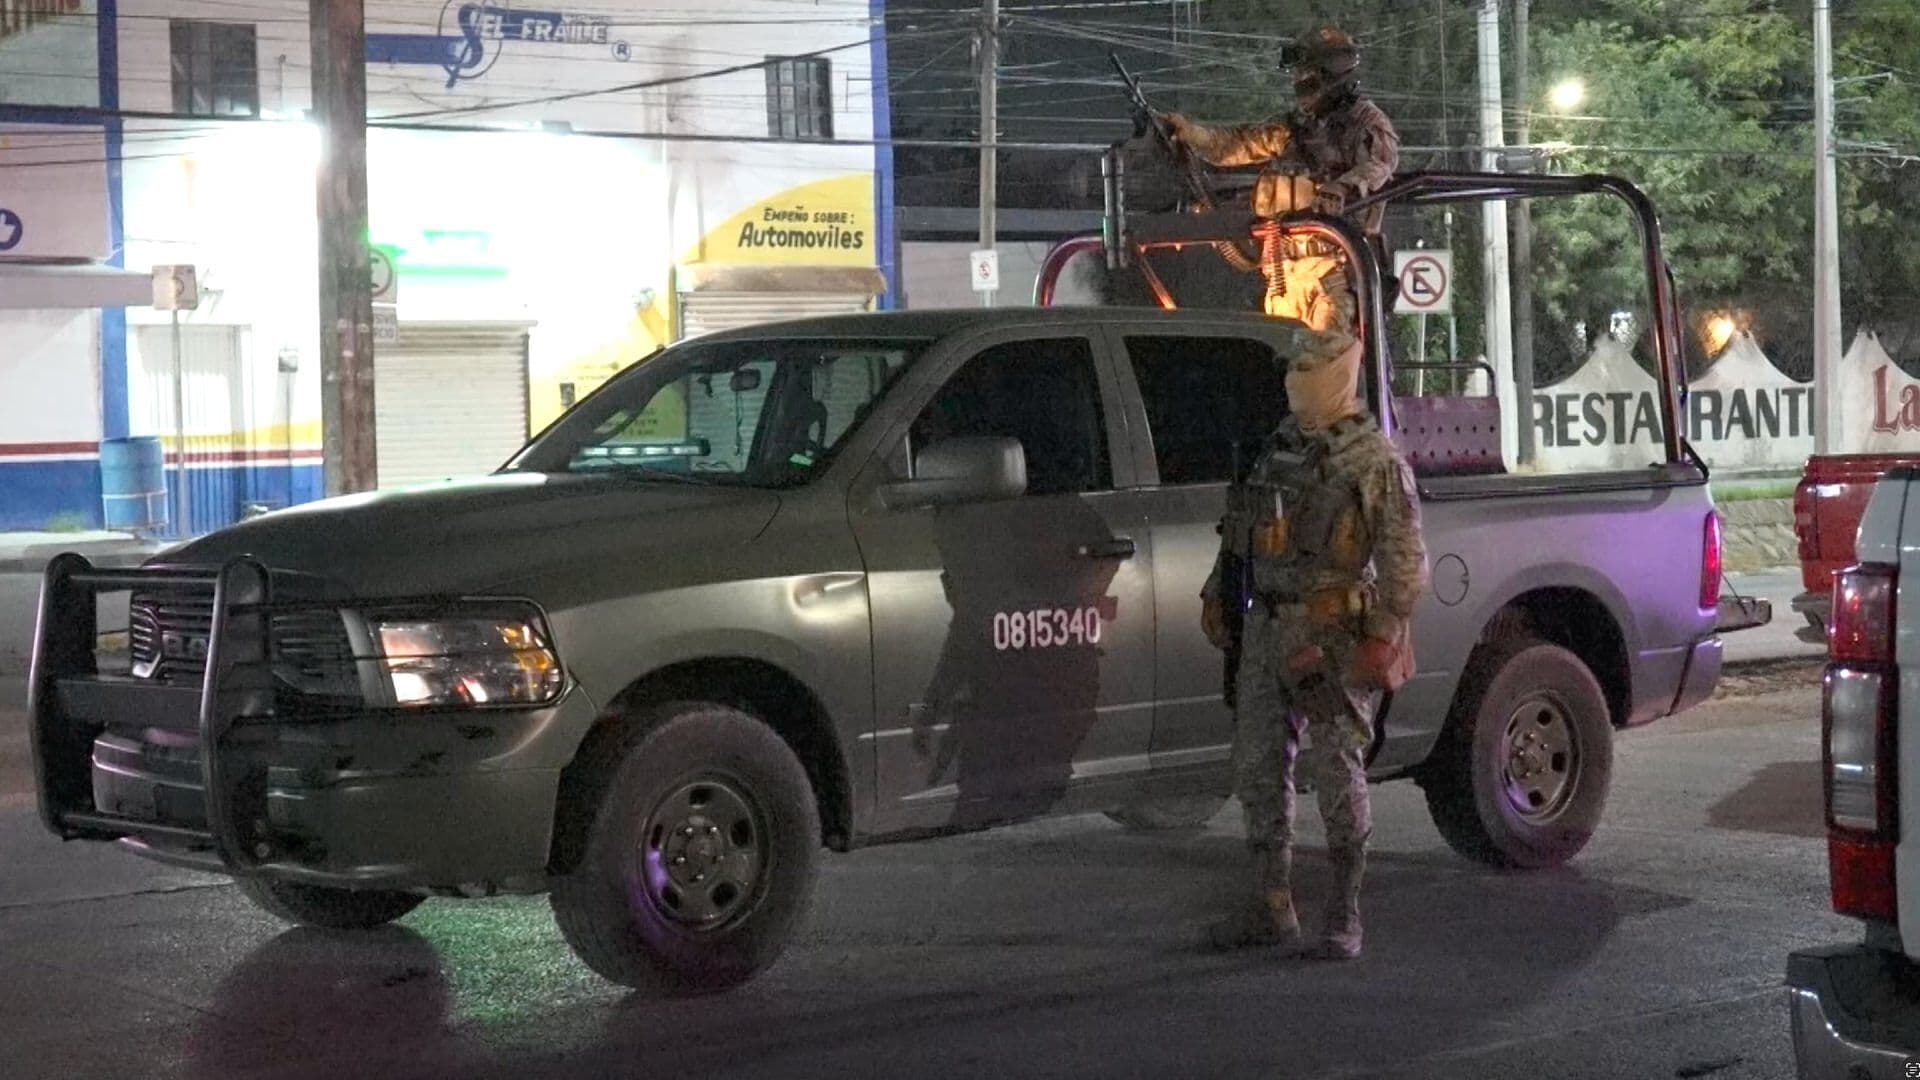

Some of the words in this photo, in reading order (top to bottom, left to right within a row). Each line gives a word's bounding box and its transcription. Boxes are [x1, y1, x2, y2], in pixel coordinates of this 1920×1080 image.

[763, 206, 809, 223] EMPEÑO
[737, 221, 864, 249] Automoviles
[1533, 388, 1815, 447] RESTARANT
[1872, 364, 1920, 437] La
[993, 606, 1101, 650] 0815340
